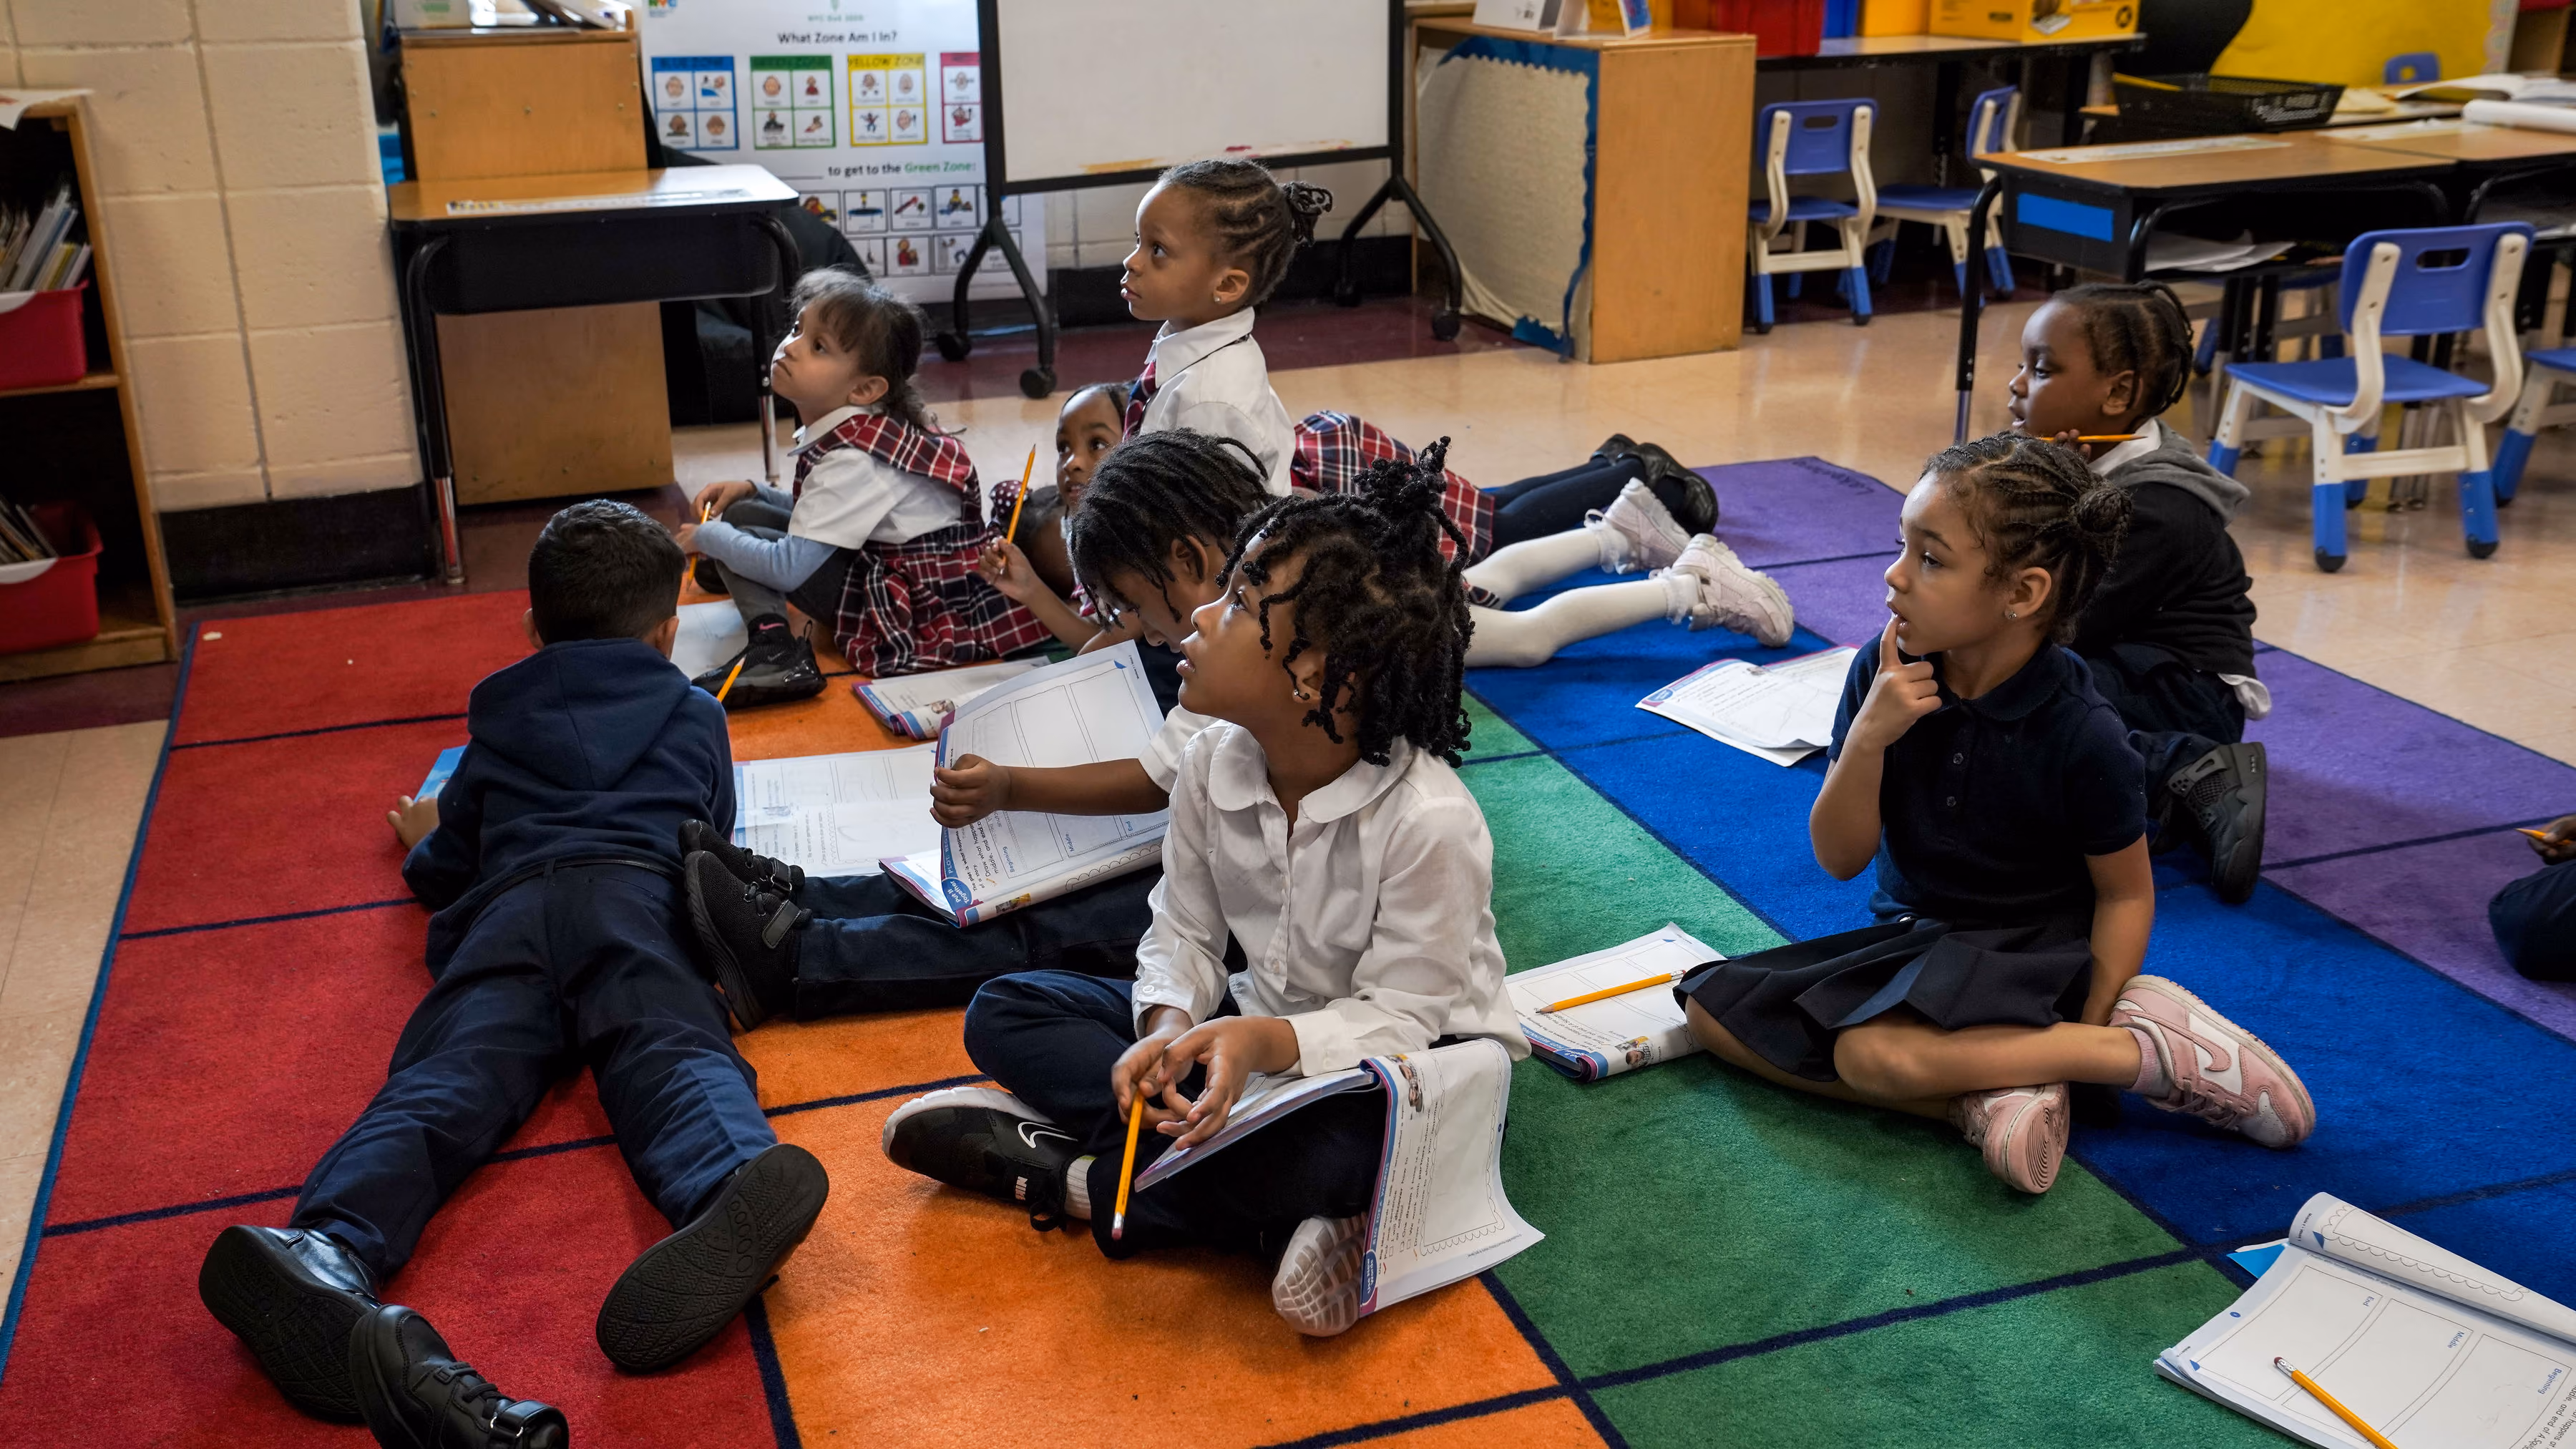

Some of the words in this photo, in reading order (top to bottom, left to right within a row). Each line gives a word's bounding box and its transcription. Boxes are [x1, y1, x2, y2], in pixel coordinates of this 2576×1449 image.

[778, 33, 810, 44] What
[815, 32, 844, 44] Zone
[849, 32, 869, 42] Am
[872, 31, 876, 42] I
[879, 30, 897, 42] In?
[847, 57, 890, 68] YELLOW
[895, 56, 923, 67] ZONE
[828, 166, 841, 176] to
[844, 166, 863, 177] get
[867, 165, 879, 175] to
[882, 163, 901, 174] the
[904, 162, 940, 173] Green
[943, 161, 976, 172] Zone:
[1125, 820, 1133, 831] End
[1065, 834, 1075, 852] Middle
[976, 846, 985, 859] what
[1002, 846, 1015, 872] Beginning
[945, 854, 953, 873] PLOT:
[989, 852, 998, 874] middle,
[950, 881, 969, 904] Together
[952, 894, 961, 902] Put
[1380, 1161, 1389, 1196] WORDS
[1394, 1187, 1402, 1220] discover
[1409, 1222, 1413, 1234] We
[2363, 1296, 2375, 1307] End
[2447, 1331, 2465, 1349] Middle
[2537, 1368, 2562, 1395] Beginning
[2555, 1404, 2567, 1416] and
[2547, 1416, 2558, 1428] end
[2554, 1418, 2574, 1440] happens
